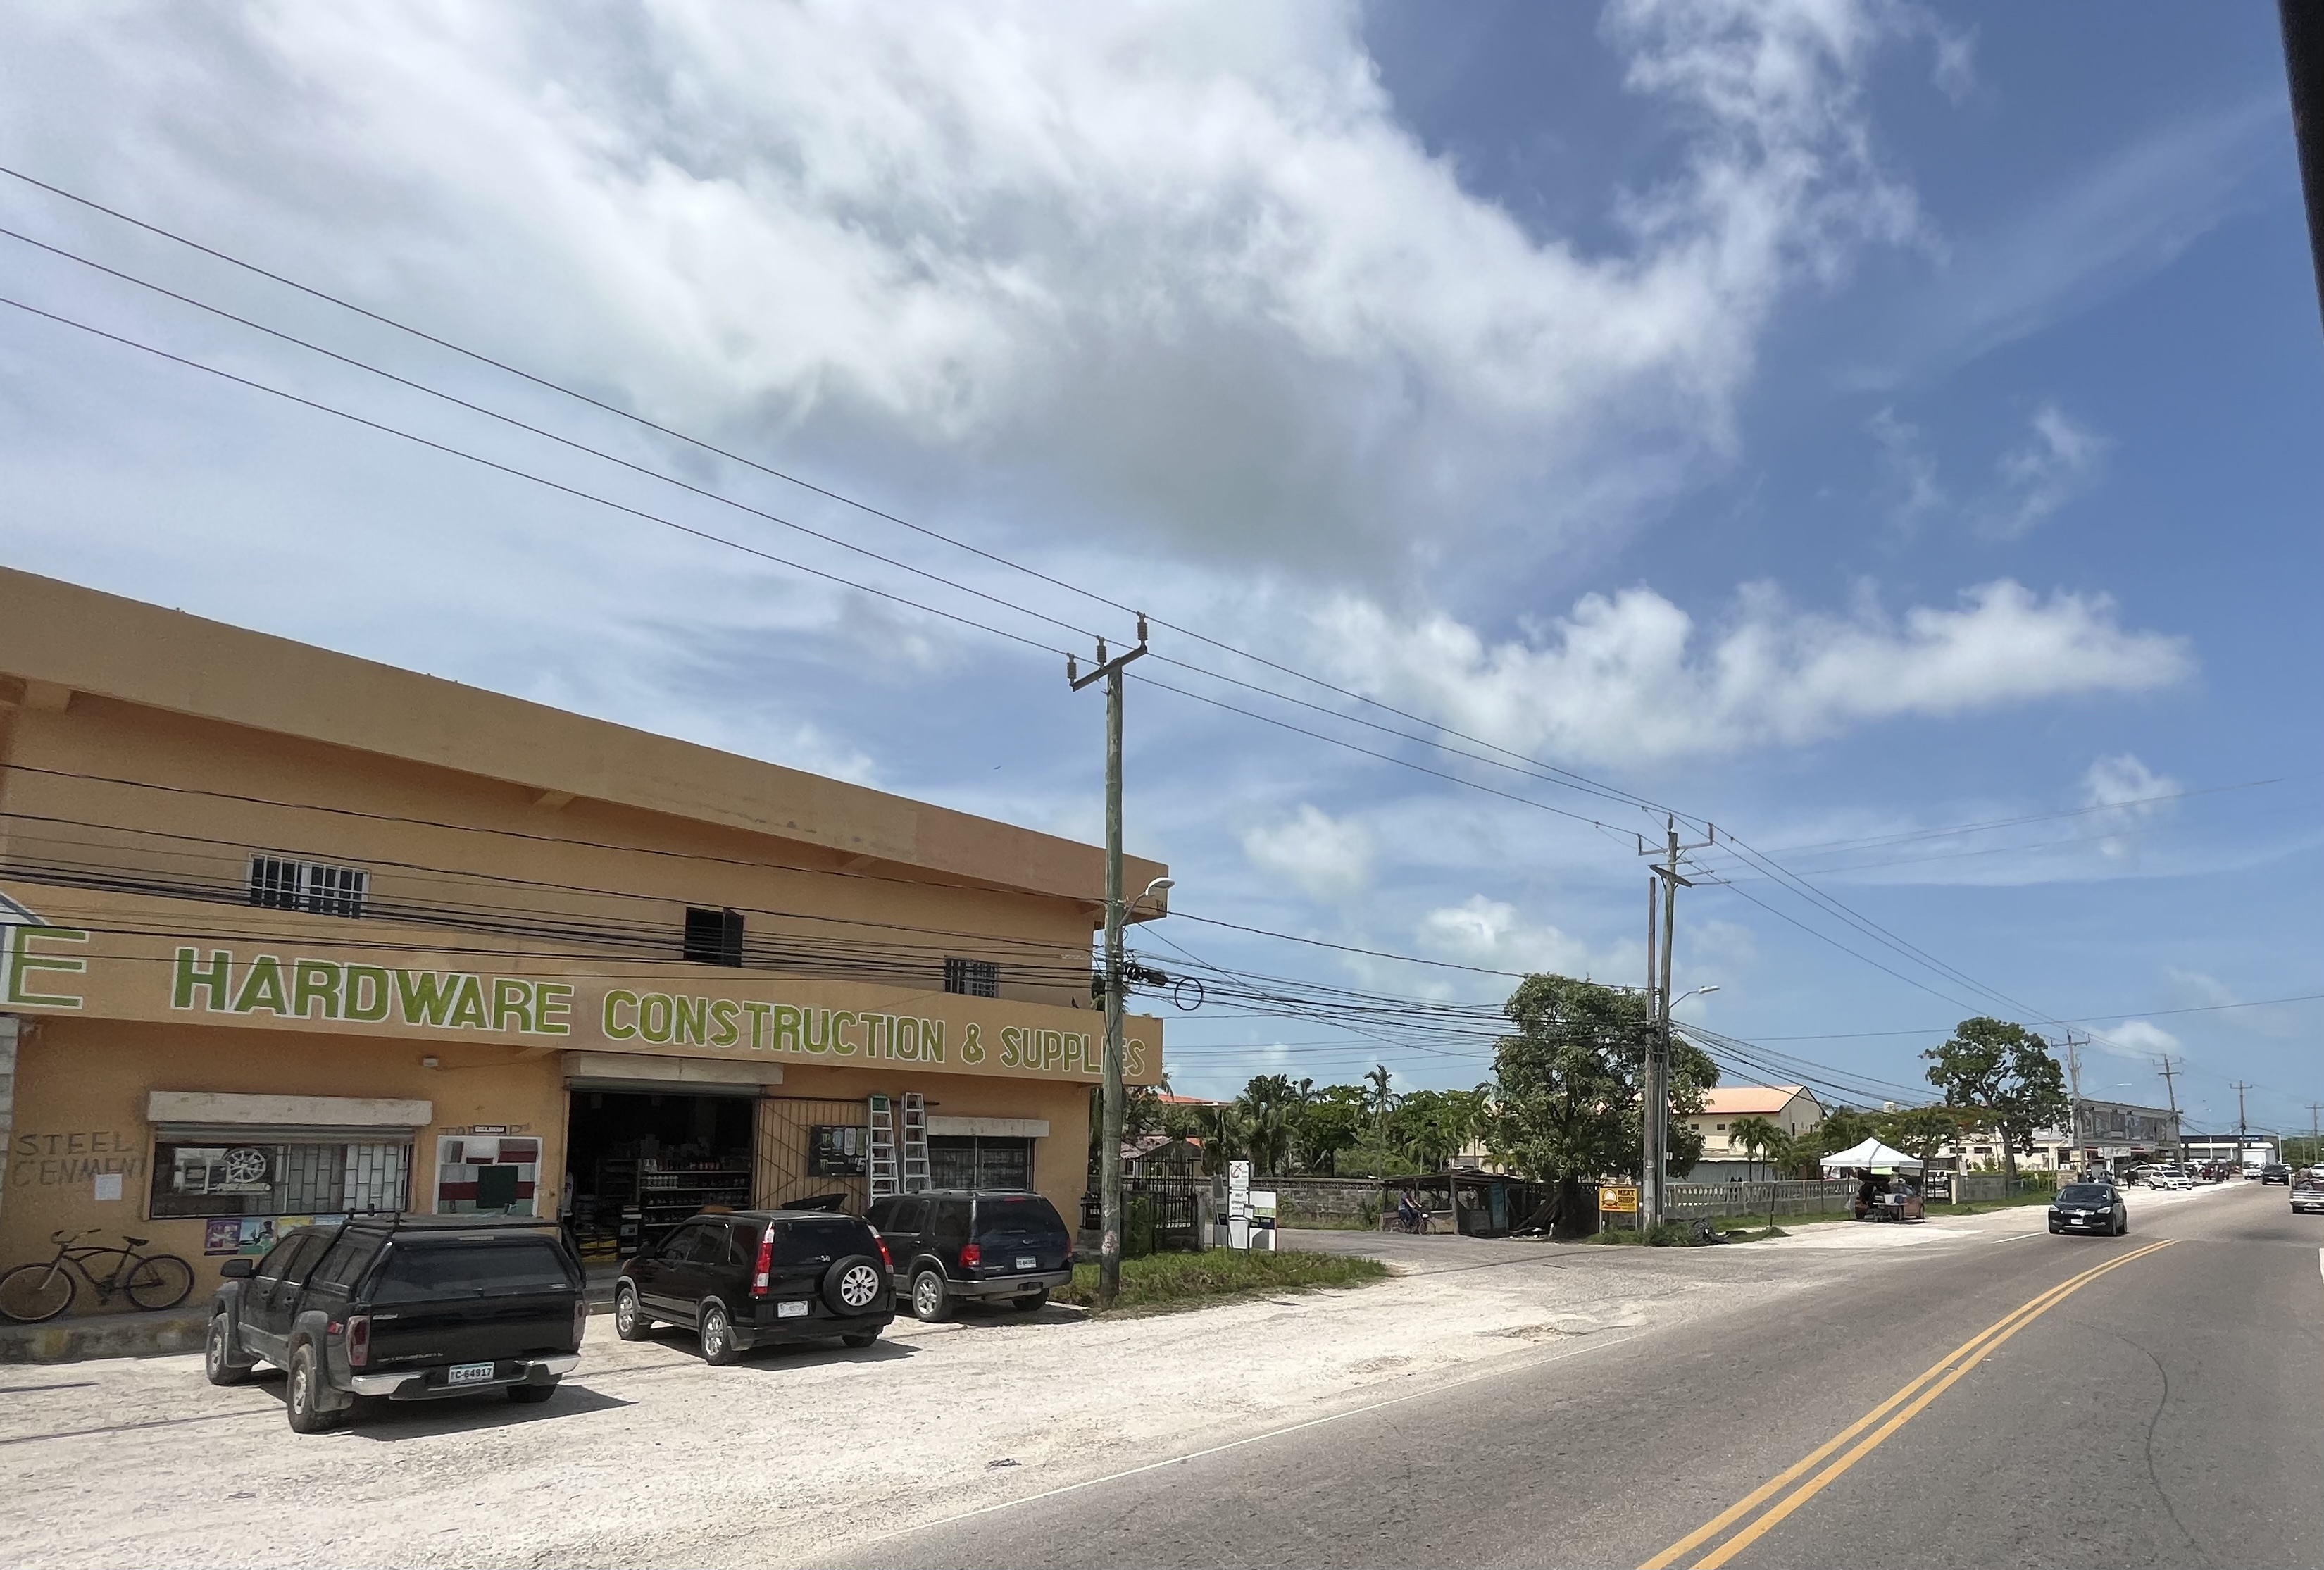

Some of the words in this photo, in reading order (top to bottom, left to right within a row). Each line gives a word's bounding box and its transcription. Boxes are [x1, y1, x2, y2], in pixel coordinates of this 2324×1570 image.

[170, 946, 575, 1035] HARDWARE
[602, 988, 946, 1064] CONSTRUCTION
[961, 1023, 986, 1065] &
[999, 1026, 1147, 1077] SUPPLS
[16, 1131, 135, 1157] STEEL
